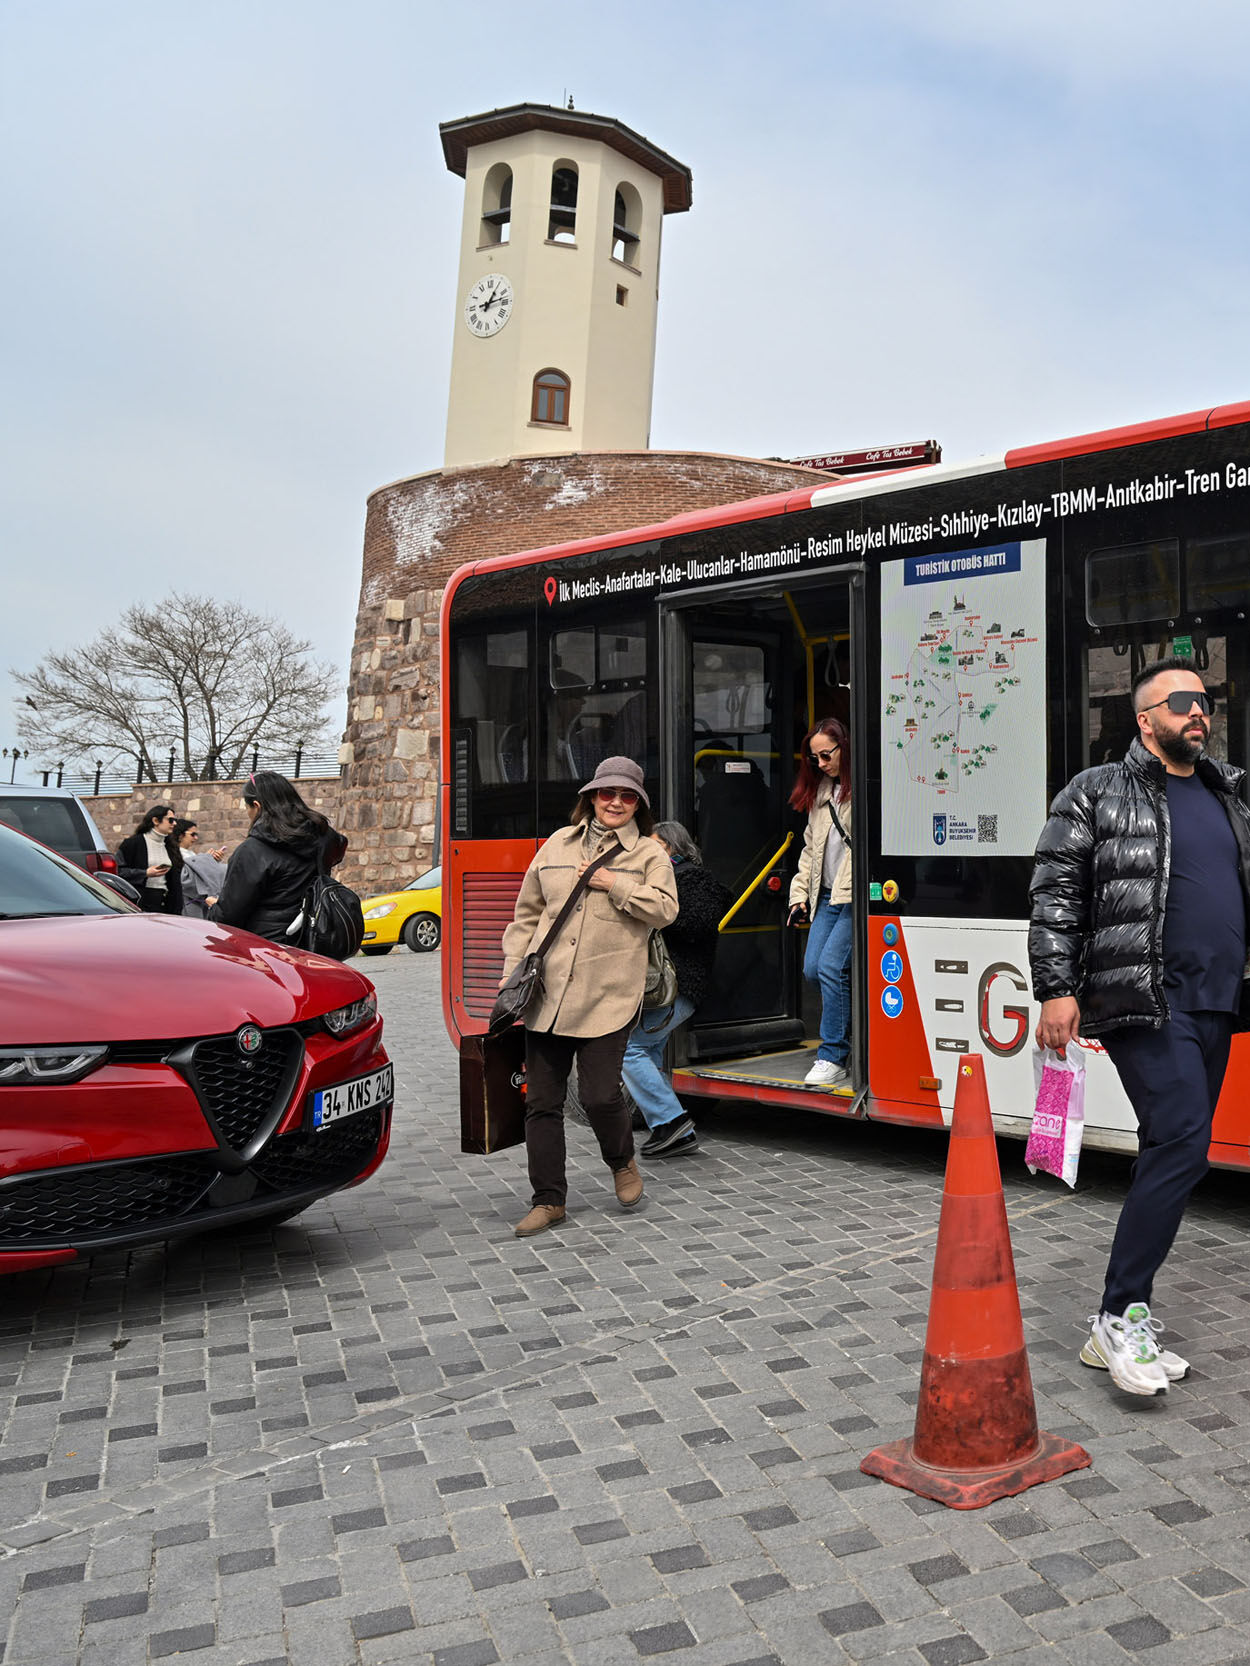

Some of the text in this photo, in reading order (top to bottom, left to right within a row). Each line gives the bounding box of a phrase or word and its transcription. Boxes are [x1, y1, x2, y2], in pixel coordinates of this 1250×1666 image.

[559, 579, 571, 602] İlk
[846, 527, 886, 555] Heykel
[915, 552, 1006, 577] TURİSTİK OTOBÜS HATTI
[935, 960, 1029, 1058] EG
[322, 1090, 341, 1119] 34
[347, 1079, 371, 1112] KNS
[375, 1070, 390, 1101] 242
